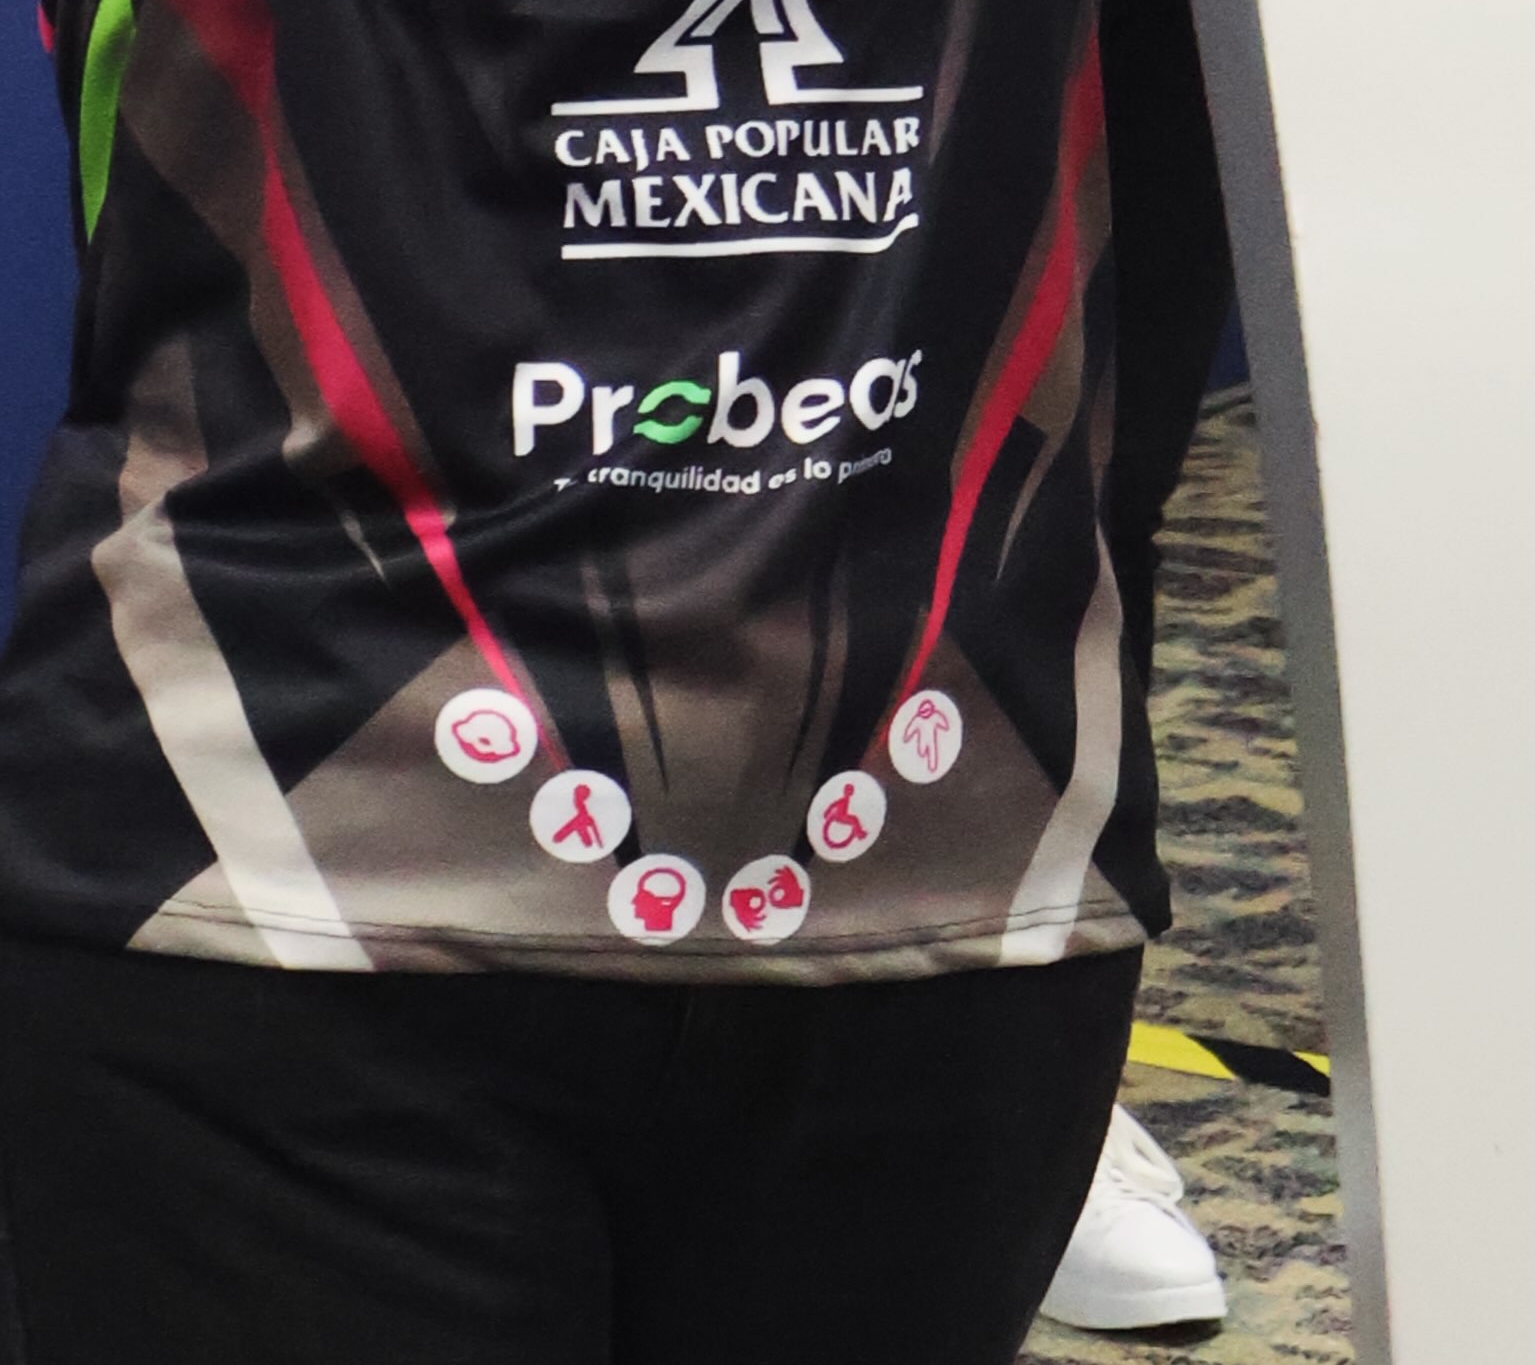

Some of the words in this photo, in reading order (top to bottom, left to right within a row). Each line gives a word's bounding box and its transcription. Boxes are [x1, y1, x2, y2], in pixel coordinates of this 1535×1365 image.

[555, 127, 691, 171] CAJA
[705, 116, 920, 160] POPULAR
[563, 167, 913, 228] MEXICANA
[512, 350, 923, 457] Probeas
[804, 457, 832, 480] lo
